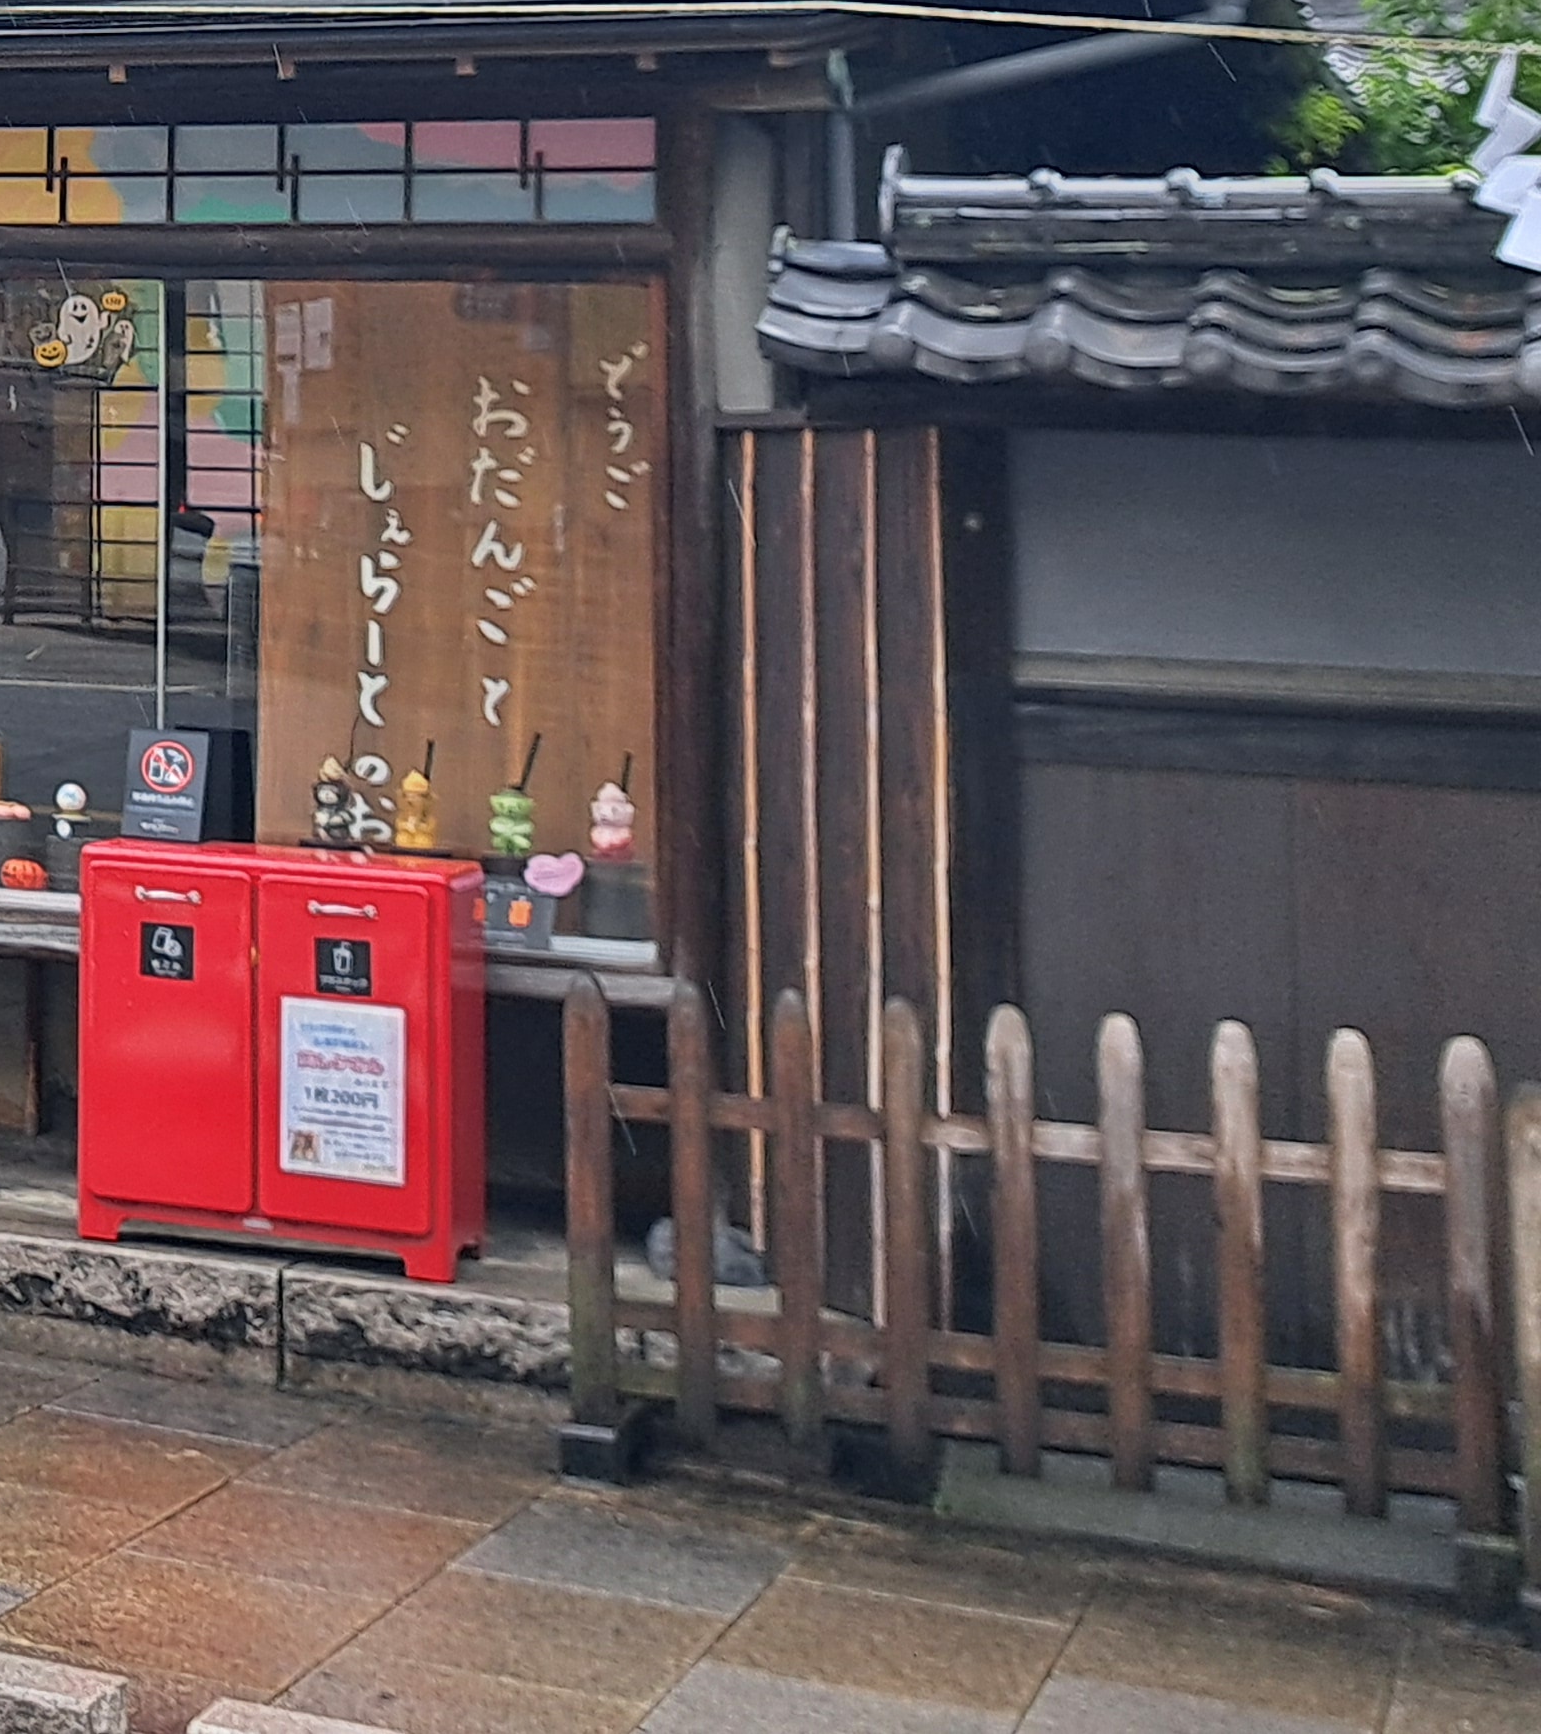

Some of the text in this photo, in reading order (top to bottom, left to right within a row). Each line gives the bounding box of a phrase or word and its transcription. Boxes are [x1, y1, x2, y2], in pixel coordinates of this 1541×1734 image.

[471, 376, 535, 728] おだんごと
[600, 342, 649, 508] どうご
